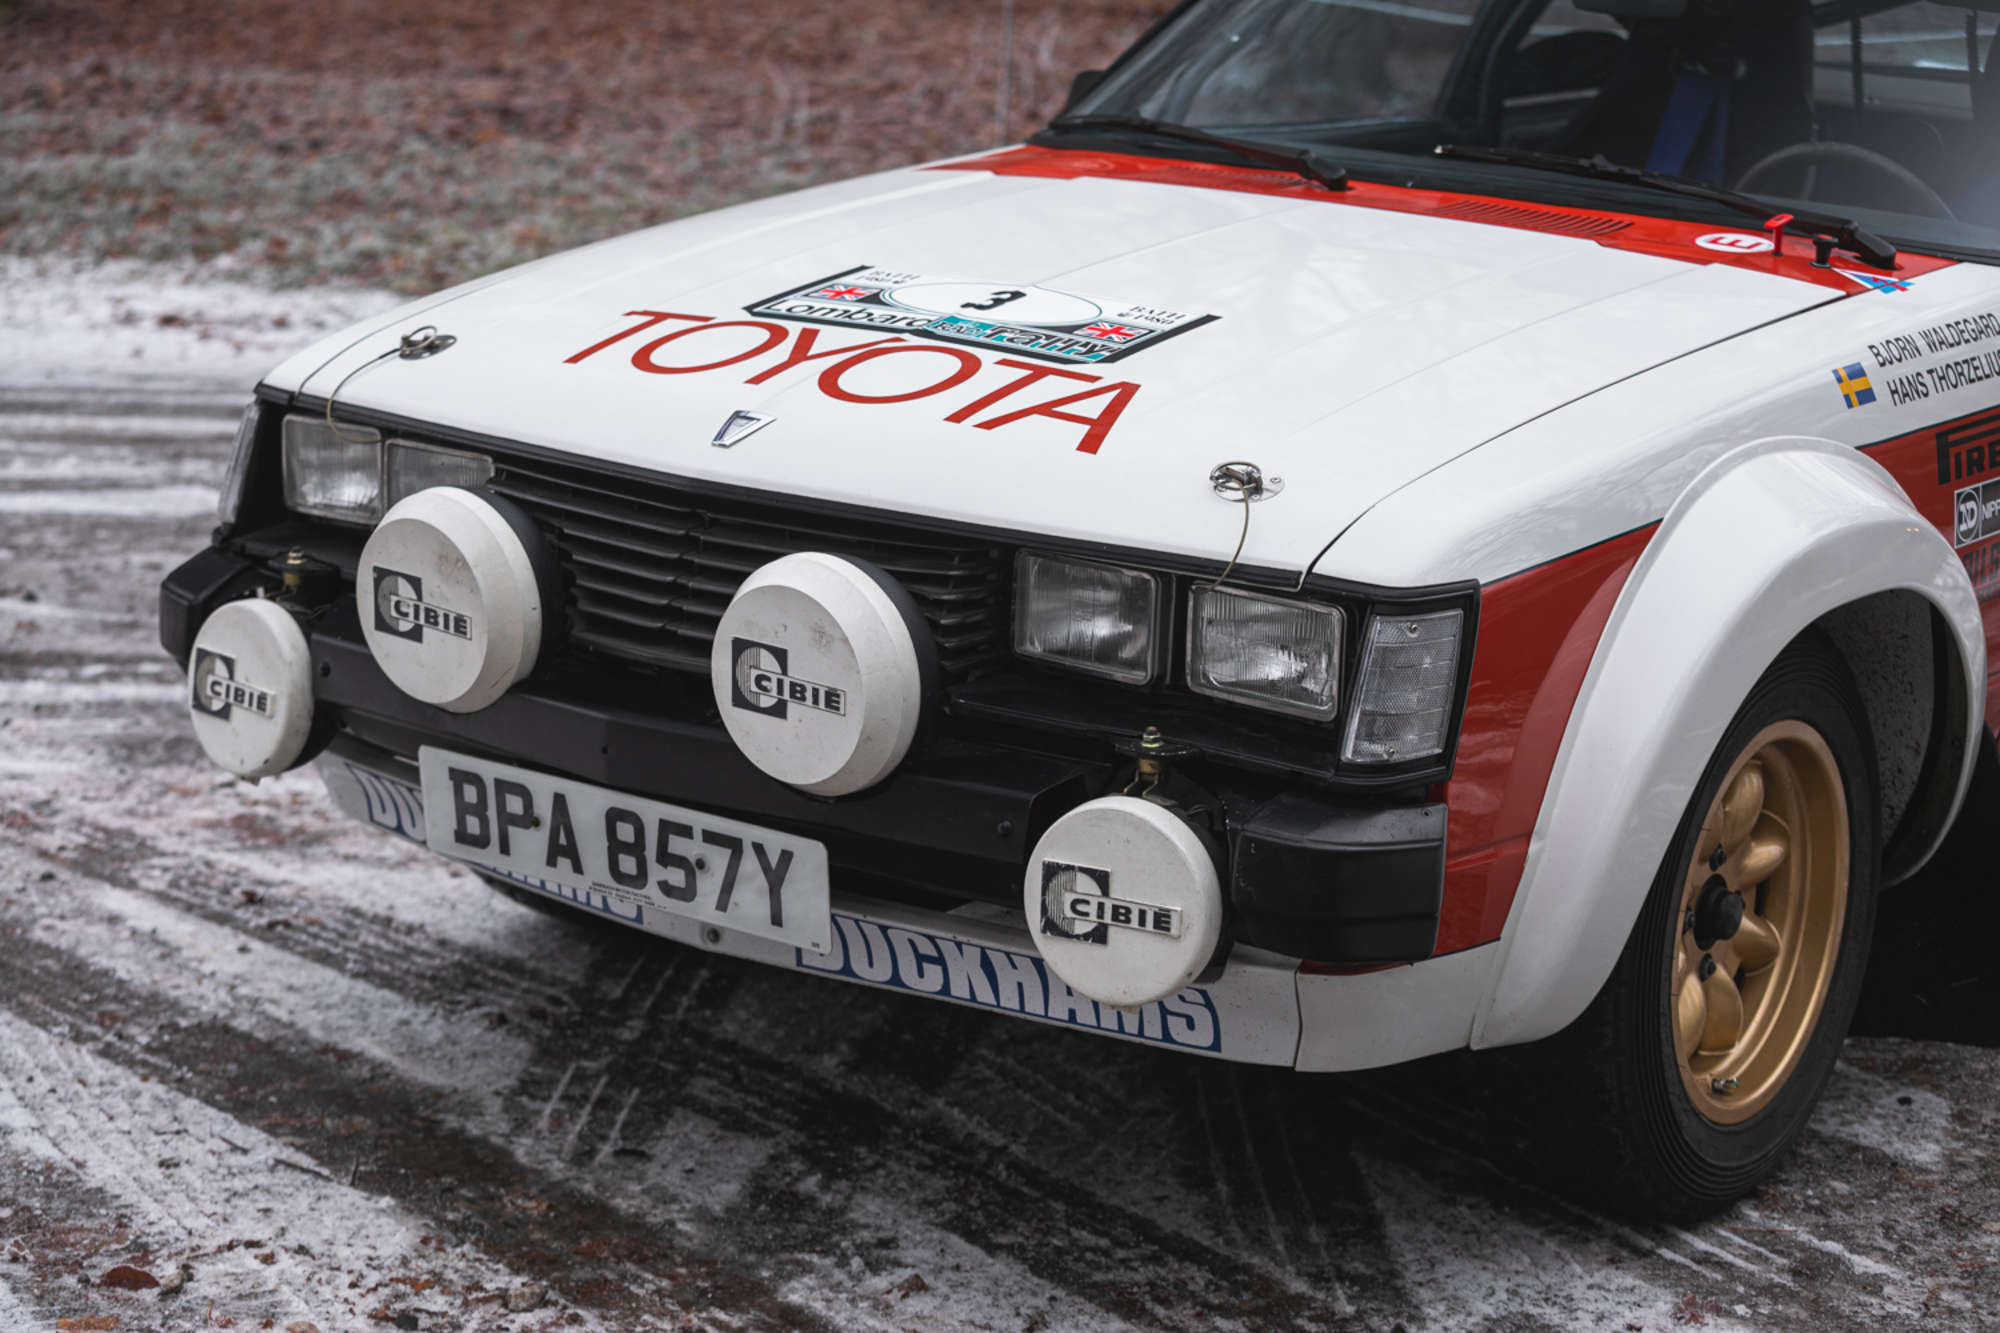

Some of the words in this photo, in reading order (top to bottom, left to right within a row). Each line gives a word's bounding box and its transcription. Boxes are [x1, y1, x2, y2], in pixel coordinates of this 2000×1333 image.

[960, 289, 1028, 311] 3
[1867, 333, 1923, 368] BJORN
[1917, 312, 2000, 354] WALDEGARD
[562, 309, 1142, 456] TOYOTA
[1886, 371, 1930, 407] HANS
[1926, 348, 2000, 395] THORZELIU
[447, 766, 585, 876] BPA
[604, 805, 795, 929] 857Y
